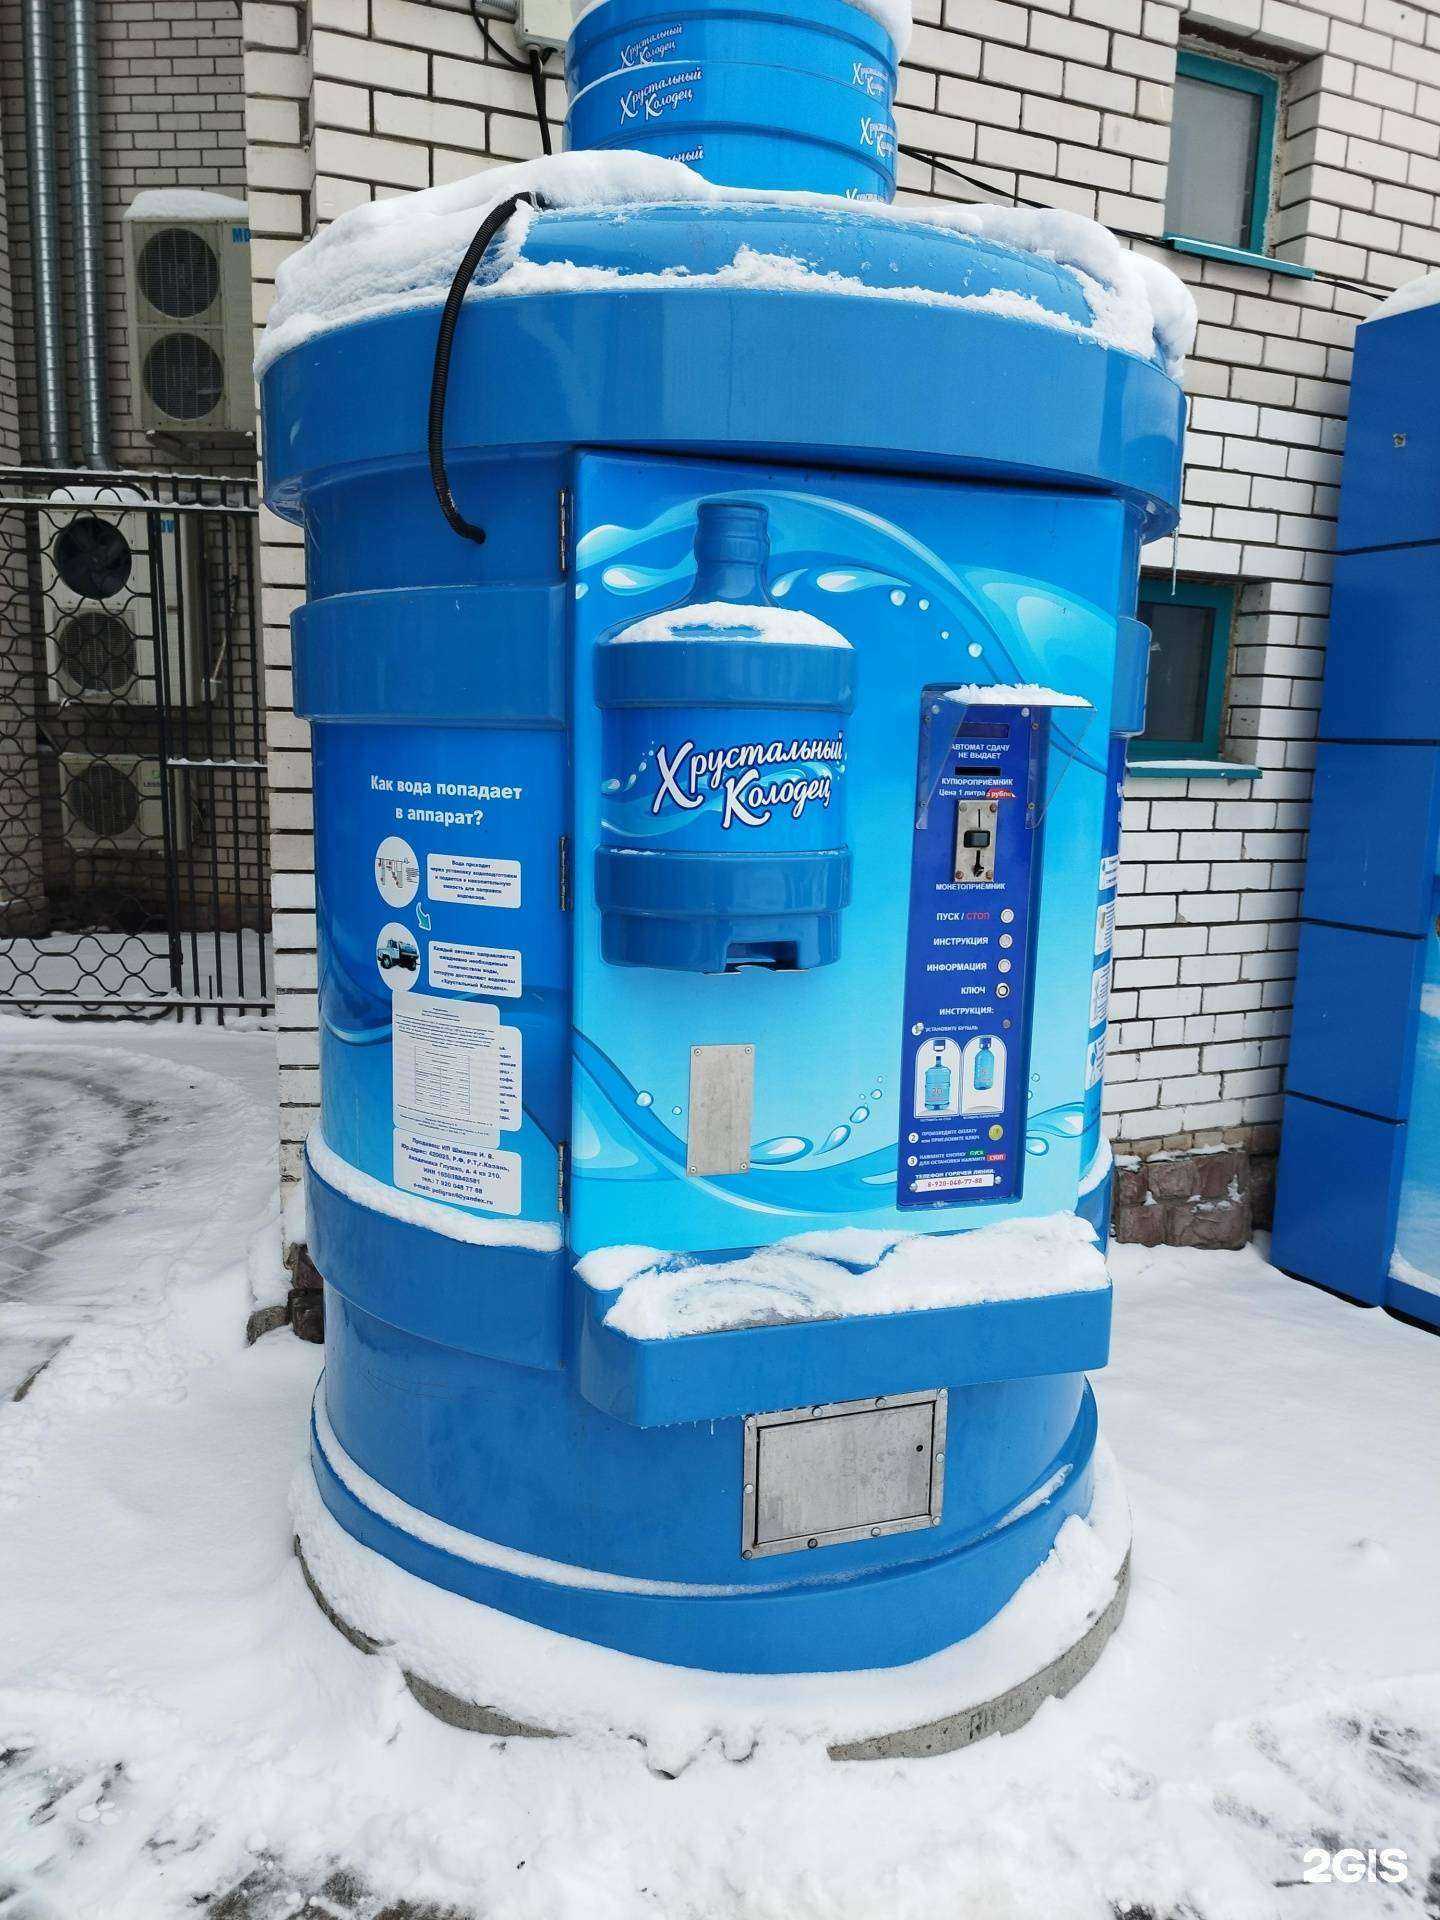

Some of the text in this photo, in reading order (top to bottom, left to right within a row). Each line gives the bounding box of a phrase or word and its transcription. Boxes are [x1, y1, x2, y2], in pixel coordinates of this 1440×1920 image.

[621, 23, 682, 70] Хрустальный
[640, 40, 676, 65] Колодец
[620, 66, 703, 126] Хрустальный
[645, 92, 693, 121] Колодец
[951, 743, 1010, 752] АВТОМАТ СДАЧУ
[970, 752, 1002, 760] ВЫДАЕТ
[652, 731, 843, 814] Хрустальный
[370, 775, 522, 800] Как вода попадает
[938, 788, 957, 797] Цена
[722, 768, 832, 830] Колодец
[395, 808, 484, 827] в аппарат?
[936, 912, 960, 921] ПУСК
[966, 912, 990, 920] СТОП
[933, 937, 989, 946] ИНСТРУКЦИЯ
[926, 962, 987, 972] ИНФОРМАЦИЯ
[960, 986, 986, 995] КЛЮЧ
[939, 1006, 994, 1016] ИНСТРУКЦИЯ:
[423, 1167, 436, 1175] ИНН
